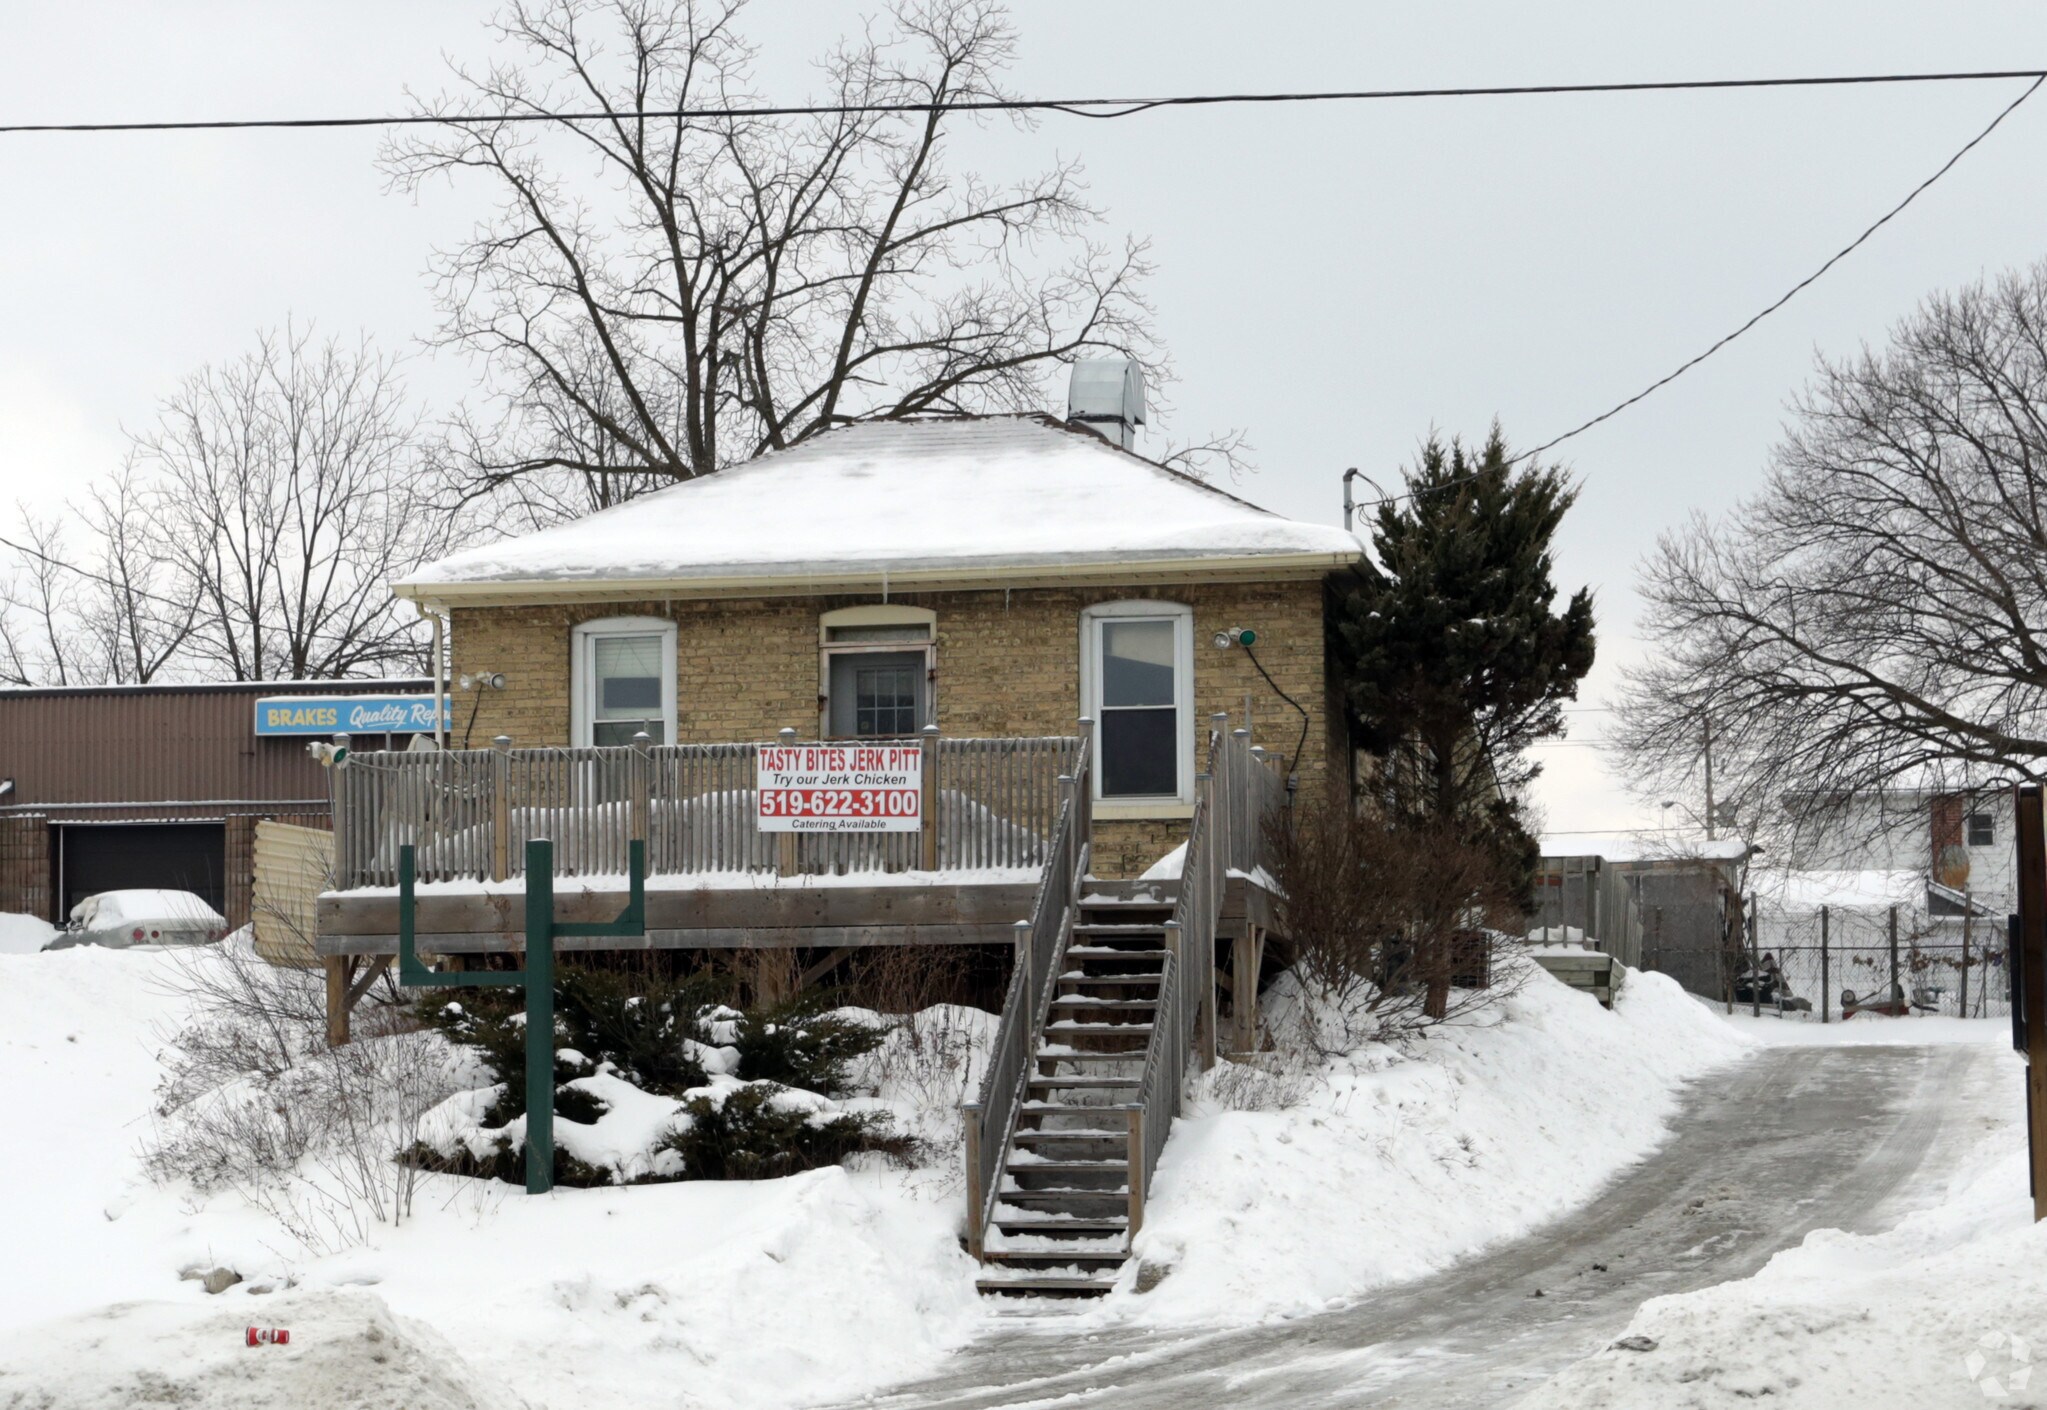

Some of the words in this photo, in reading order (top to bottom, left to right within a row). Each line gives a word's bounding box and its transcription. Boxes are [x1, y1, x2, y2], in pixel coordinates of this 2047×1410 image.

[267, 708, 338, 727] BRAKES
[350, 704, 408, 729] Quality
[760, 749, 801, 771] TASTY
[806, 749, 845, 771] BITES
[850, 749, 885, 771] JERK
[889, 749, 920, 771] PITT
[773, 773, 793, 787] Try
[796, 776, 818, 785] our
[822, 773, 850, 785] Jerk
[854, 773, 907, 785] Chicken
[762, 791, 916, 815] 519-622-3100
[792, 819, 836, 831] Catering
[839, 819, 887, 829] Available
